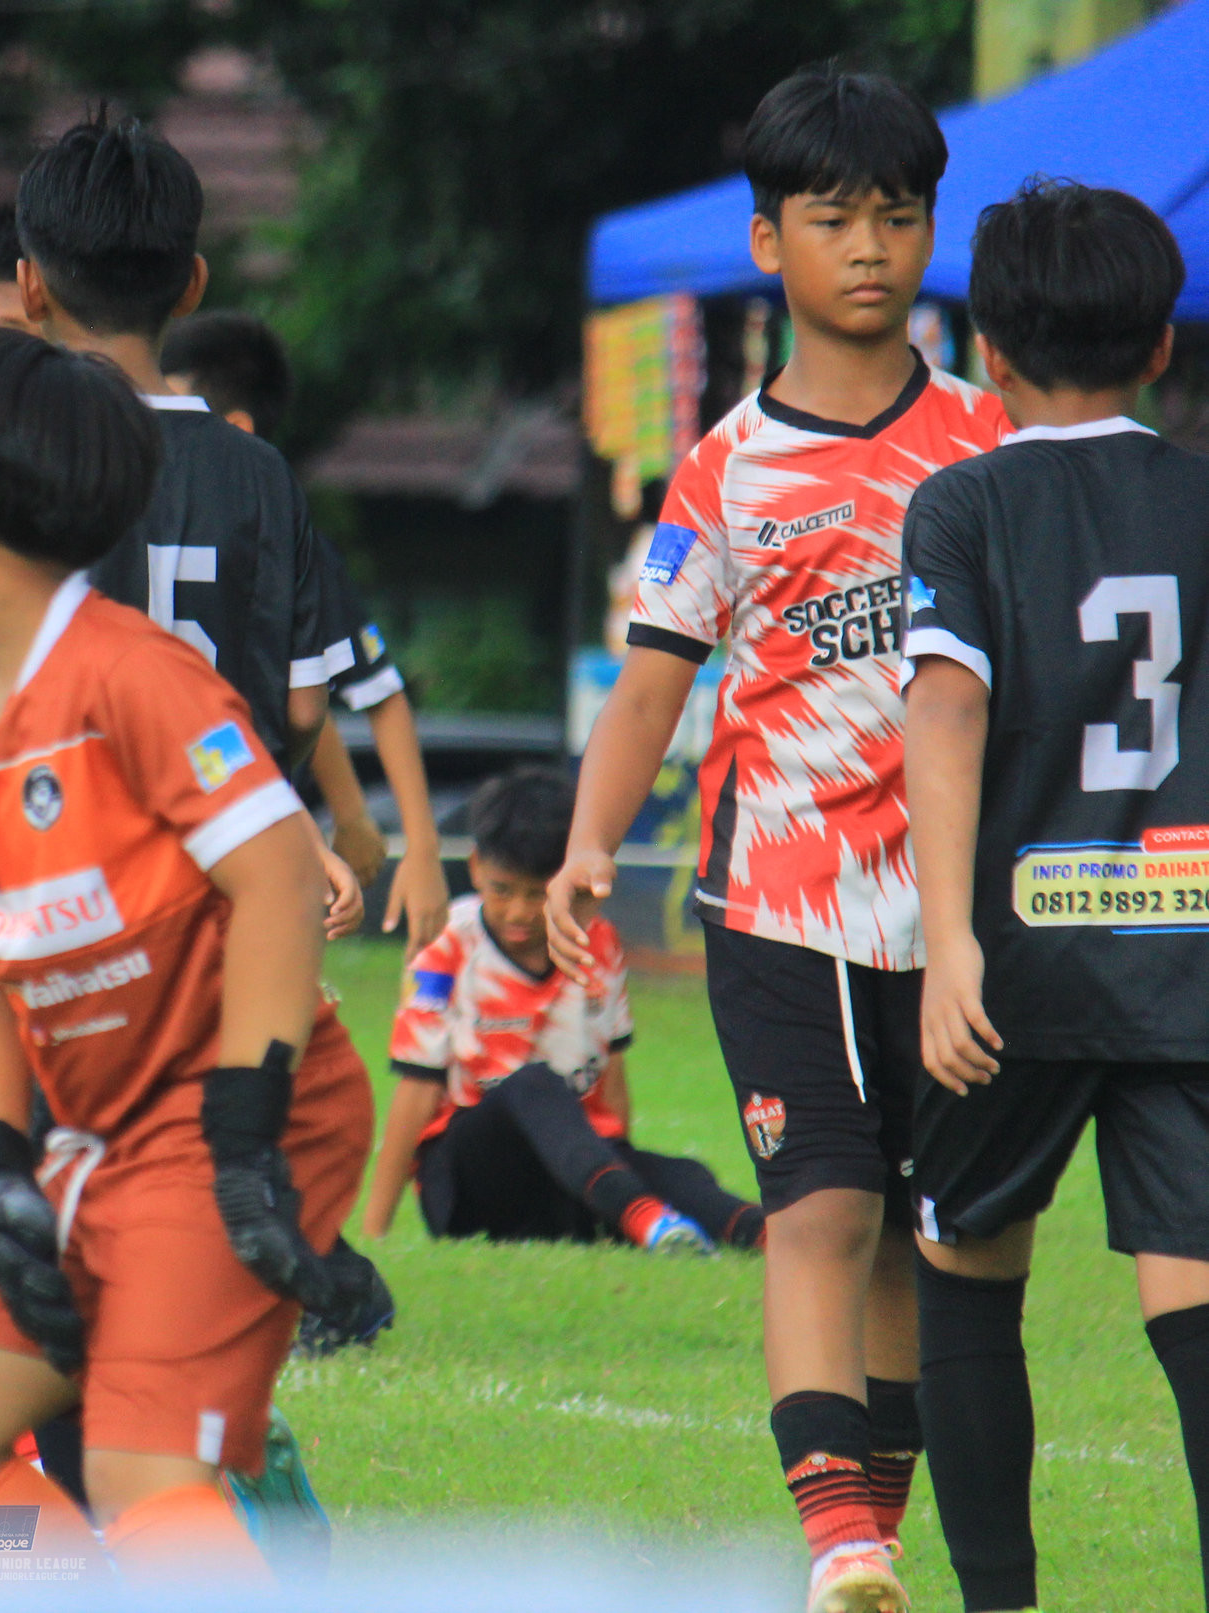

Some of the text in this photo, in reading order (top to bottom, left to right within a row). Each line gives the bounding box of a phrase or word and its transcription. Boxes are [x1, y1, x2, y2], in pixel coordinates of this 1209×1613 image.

[781, 504, 853, 540] CALCETTO
[147, 543, 218, 671] 5
[809, 605, 902, 667] SCH
[1079, 574, 1182, 792] 3
[1032, 864, 1073, 880] INFO
[1078, 862, 1139, 879] PROMO
[1031, 890, 1094, 915] 0812
[1100, 889, 1166, 914] 9892
